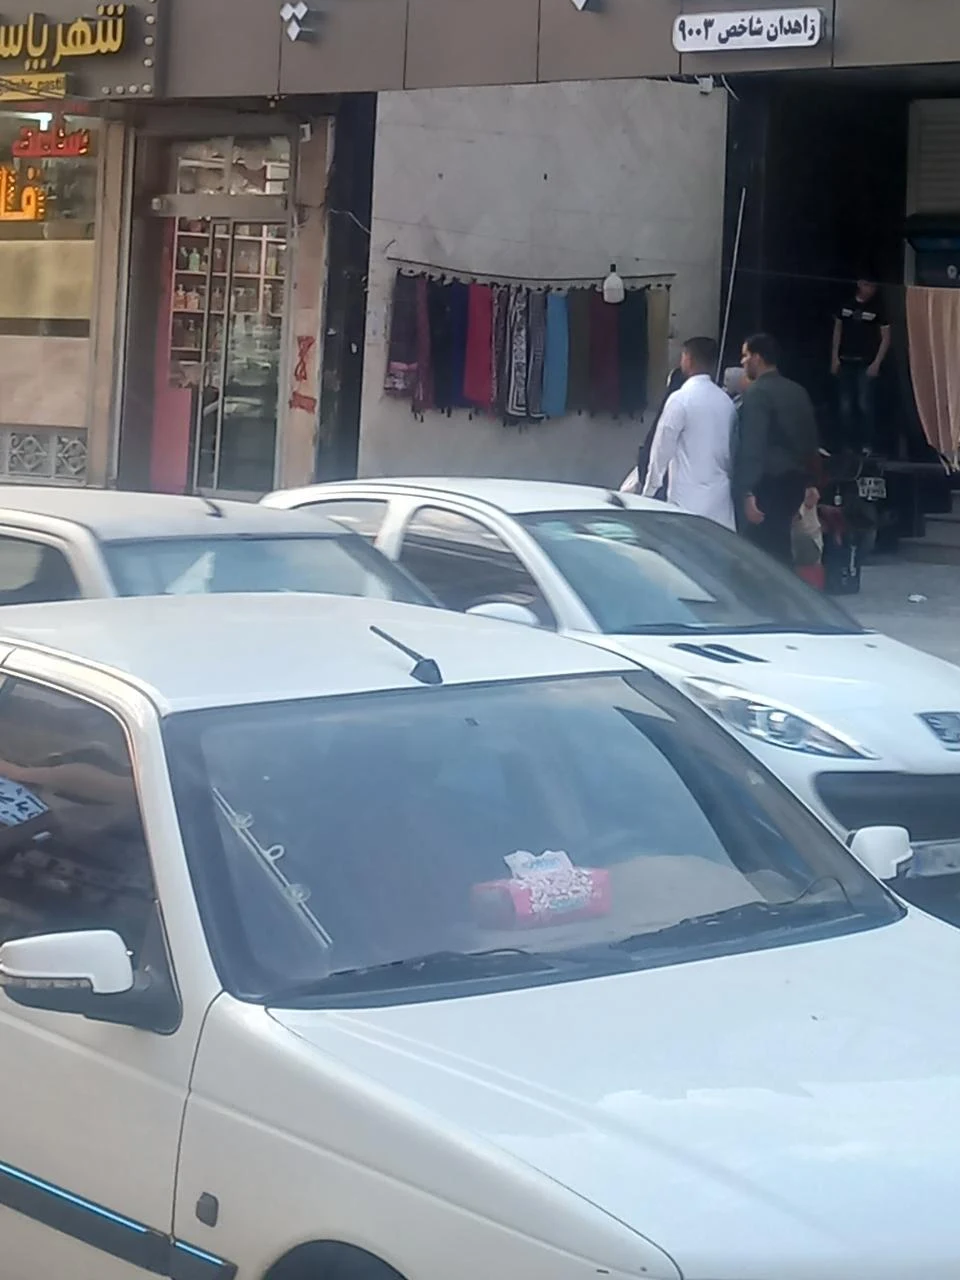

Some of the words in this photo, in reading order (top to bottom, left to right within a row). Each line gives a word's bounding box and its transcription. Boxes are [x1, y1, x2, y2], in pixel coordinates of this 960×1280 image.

[52, 4, 125, 67] شهر
[718, 15, 763, 44] شاخص
[767, 14, 816, 41] زاهدان
